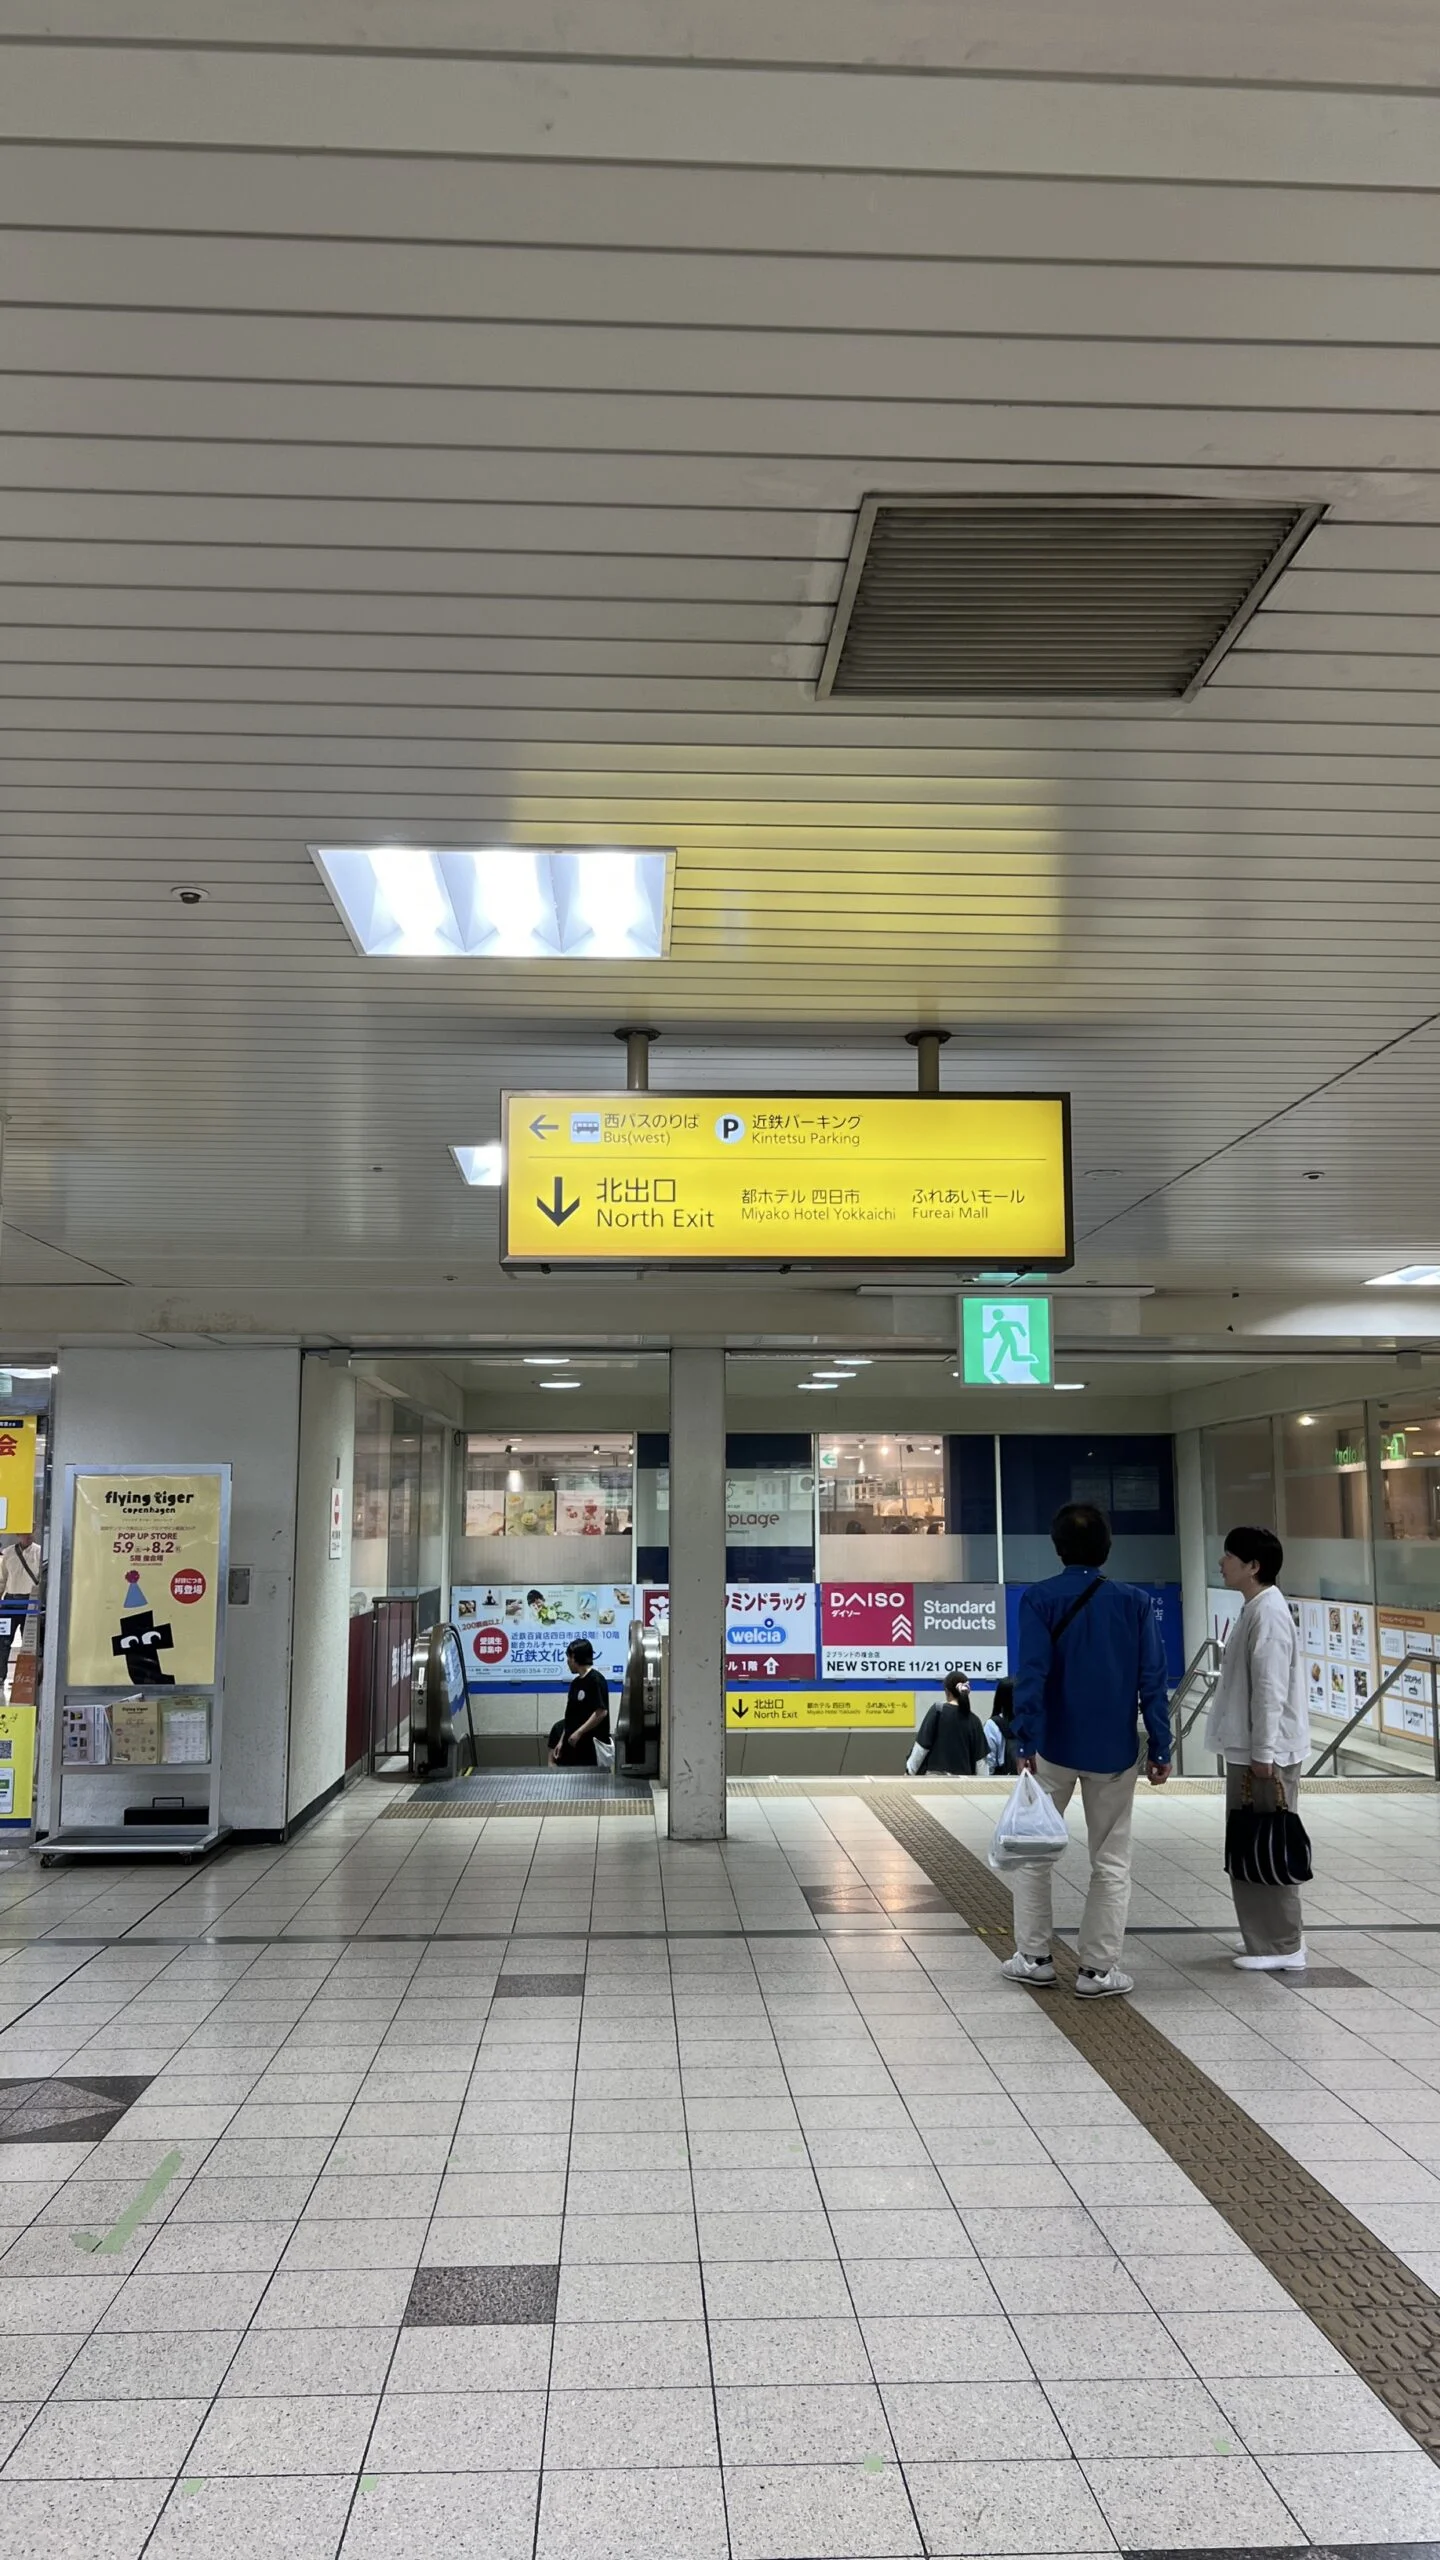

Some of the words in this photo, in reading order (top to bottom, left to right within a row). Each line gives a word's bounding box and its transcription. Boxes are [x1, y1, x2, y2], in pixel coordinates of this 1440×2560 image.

[604, 1112, 699, 1129] 西バスのりば
[751, 1113, 862, 1130] 近鉄パーキング
[604, 1131, 671, 1147] Bus(west)
[752, 1131, 806, 1145] Kintetsu
[810, 1131, 861, 1147] Parking
[597, 1177, 677, 1204] 北出口
[741, 1188, 806, 1205] 都ホテル
[811, 1188, 860, 1205] 四日市
[912, 1188, 1025, 1205] ふれあいモール
[596, 1208, 664, 1229] North
[672, 1208, 715, 1229] Exit
[741, 1206, 790, 1222] Miyako
[794, 1206, 830, 1221] Hotel
[834, 1206, 896, 1221] Yokkaichi
[912, 1206, 955, 1221] Fureai
[958, 1206, 989, 1221] Mall
[105, 1490, 151, 1507] flying
[153, 1490, 194, 1507] tiger
[122, 1507, 175, 1515] copenhagen
[137, 1532, 149, 1540] UP
[150, 1532, 178, 1540] STORE
[113, 1542, 134, 1553] 5.9
[152, 1542, 174, 1553] 8.2
[830, 1592, 906, 1609] DAISO
[923, 1599, 996, 1615] Standard
[831, 1610, 862, 1619] ダイソー
[731, 1618, 782, 1643] welcia
[924, 1615, 997, 1631] Products
[826, 1660, 857, 1672] NEW
[860, 1660, 906, 1672] STORE
[908, 1660, 941, 1672] 11/21
[944, 1660, 982, 1672] OPEN
[986, 1660, 1004, 1672] 6F
[753, 1698, 784, 1709] 北出口
[753, 1710, 779, 1719] North
[781, 1710, 798, 1719] Exit
